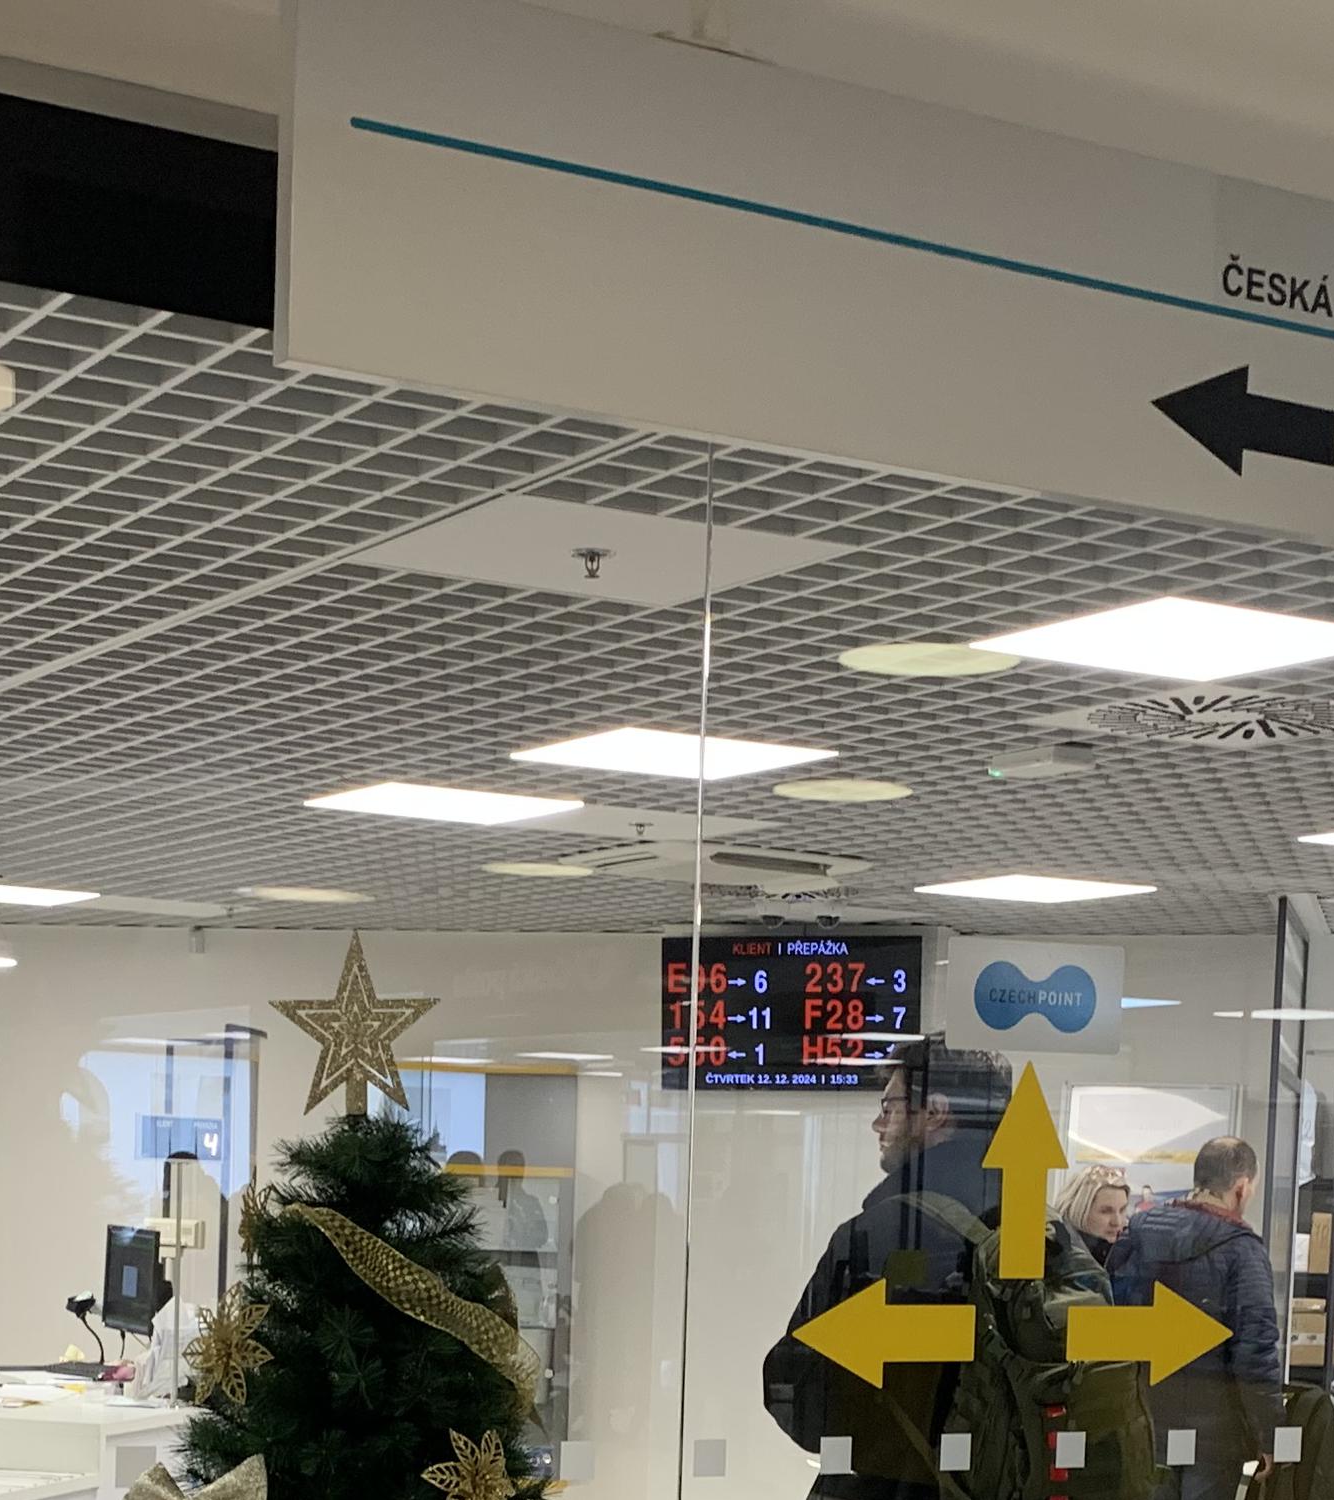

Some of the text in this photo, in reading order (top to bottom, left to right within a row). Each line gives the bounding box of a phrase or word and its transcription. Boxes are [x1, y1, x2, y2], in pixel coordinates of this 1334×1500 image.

[1221, 253, 1332, 318] ČESKÁ
[732, 943, 772, 955] KLIENT
[787, 940, 849, 955] PŘEPÁŽKA
[754, 970, 768, 993] 6
[805, 962, 907, 993] 237 3
[749, 1006, 772, 1030] 11
[804, 999, 907, 1030] F28 7
[755, 1043, 765, 1066] 1
[705, 1073, 755, 1085] ČTVRTEK
[757, 1074, 772, 1084] 12.
[774, 1074, 790, 1084] 12.
[791, 1074, 816, 1084] 2024
[830, 1074, 858, 1085] 15:33
[203, 1132, 219, 1157] 4
